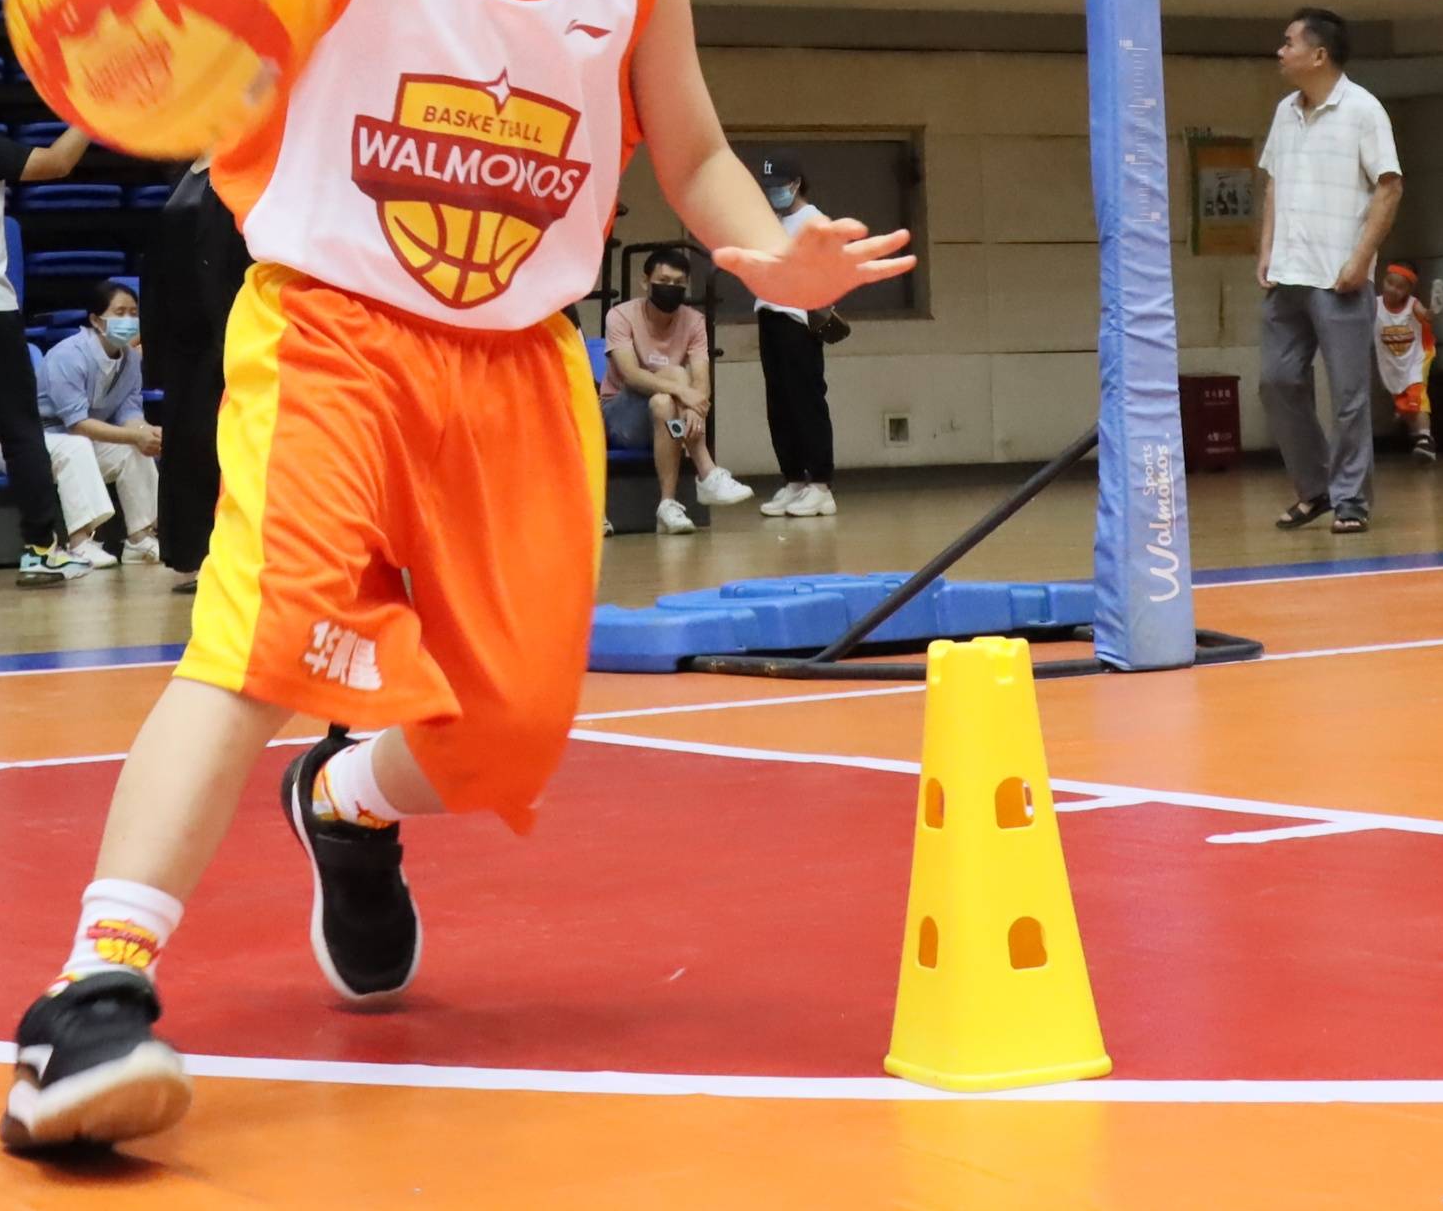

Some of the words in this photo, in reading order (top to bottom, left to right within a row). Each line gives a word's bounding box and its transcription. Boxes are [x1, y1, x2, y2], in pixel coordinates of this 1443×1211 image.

[423, 105, 543, 144] BASKETALL
[359, 126, 580, 201] WALMONOS
[1143, 444, 1157, 496] Sports
[1146, 444, 1180, 603] Walmonos
